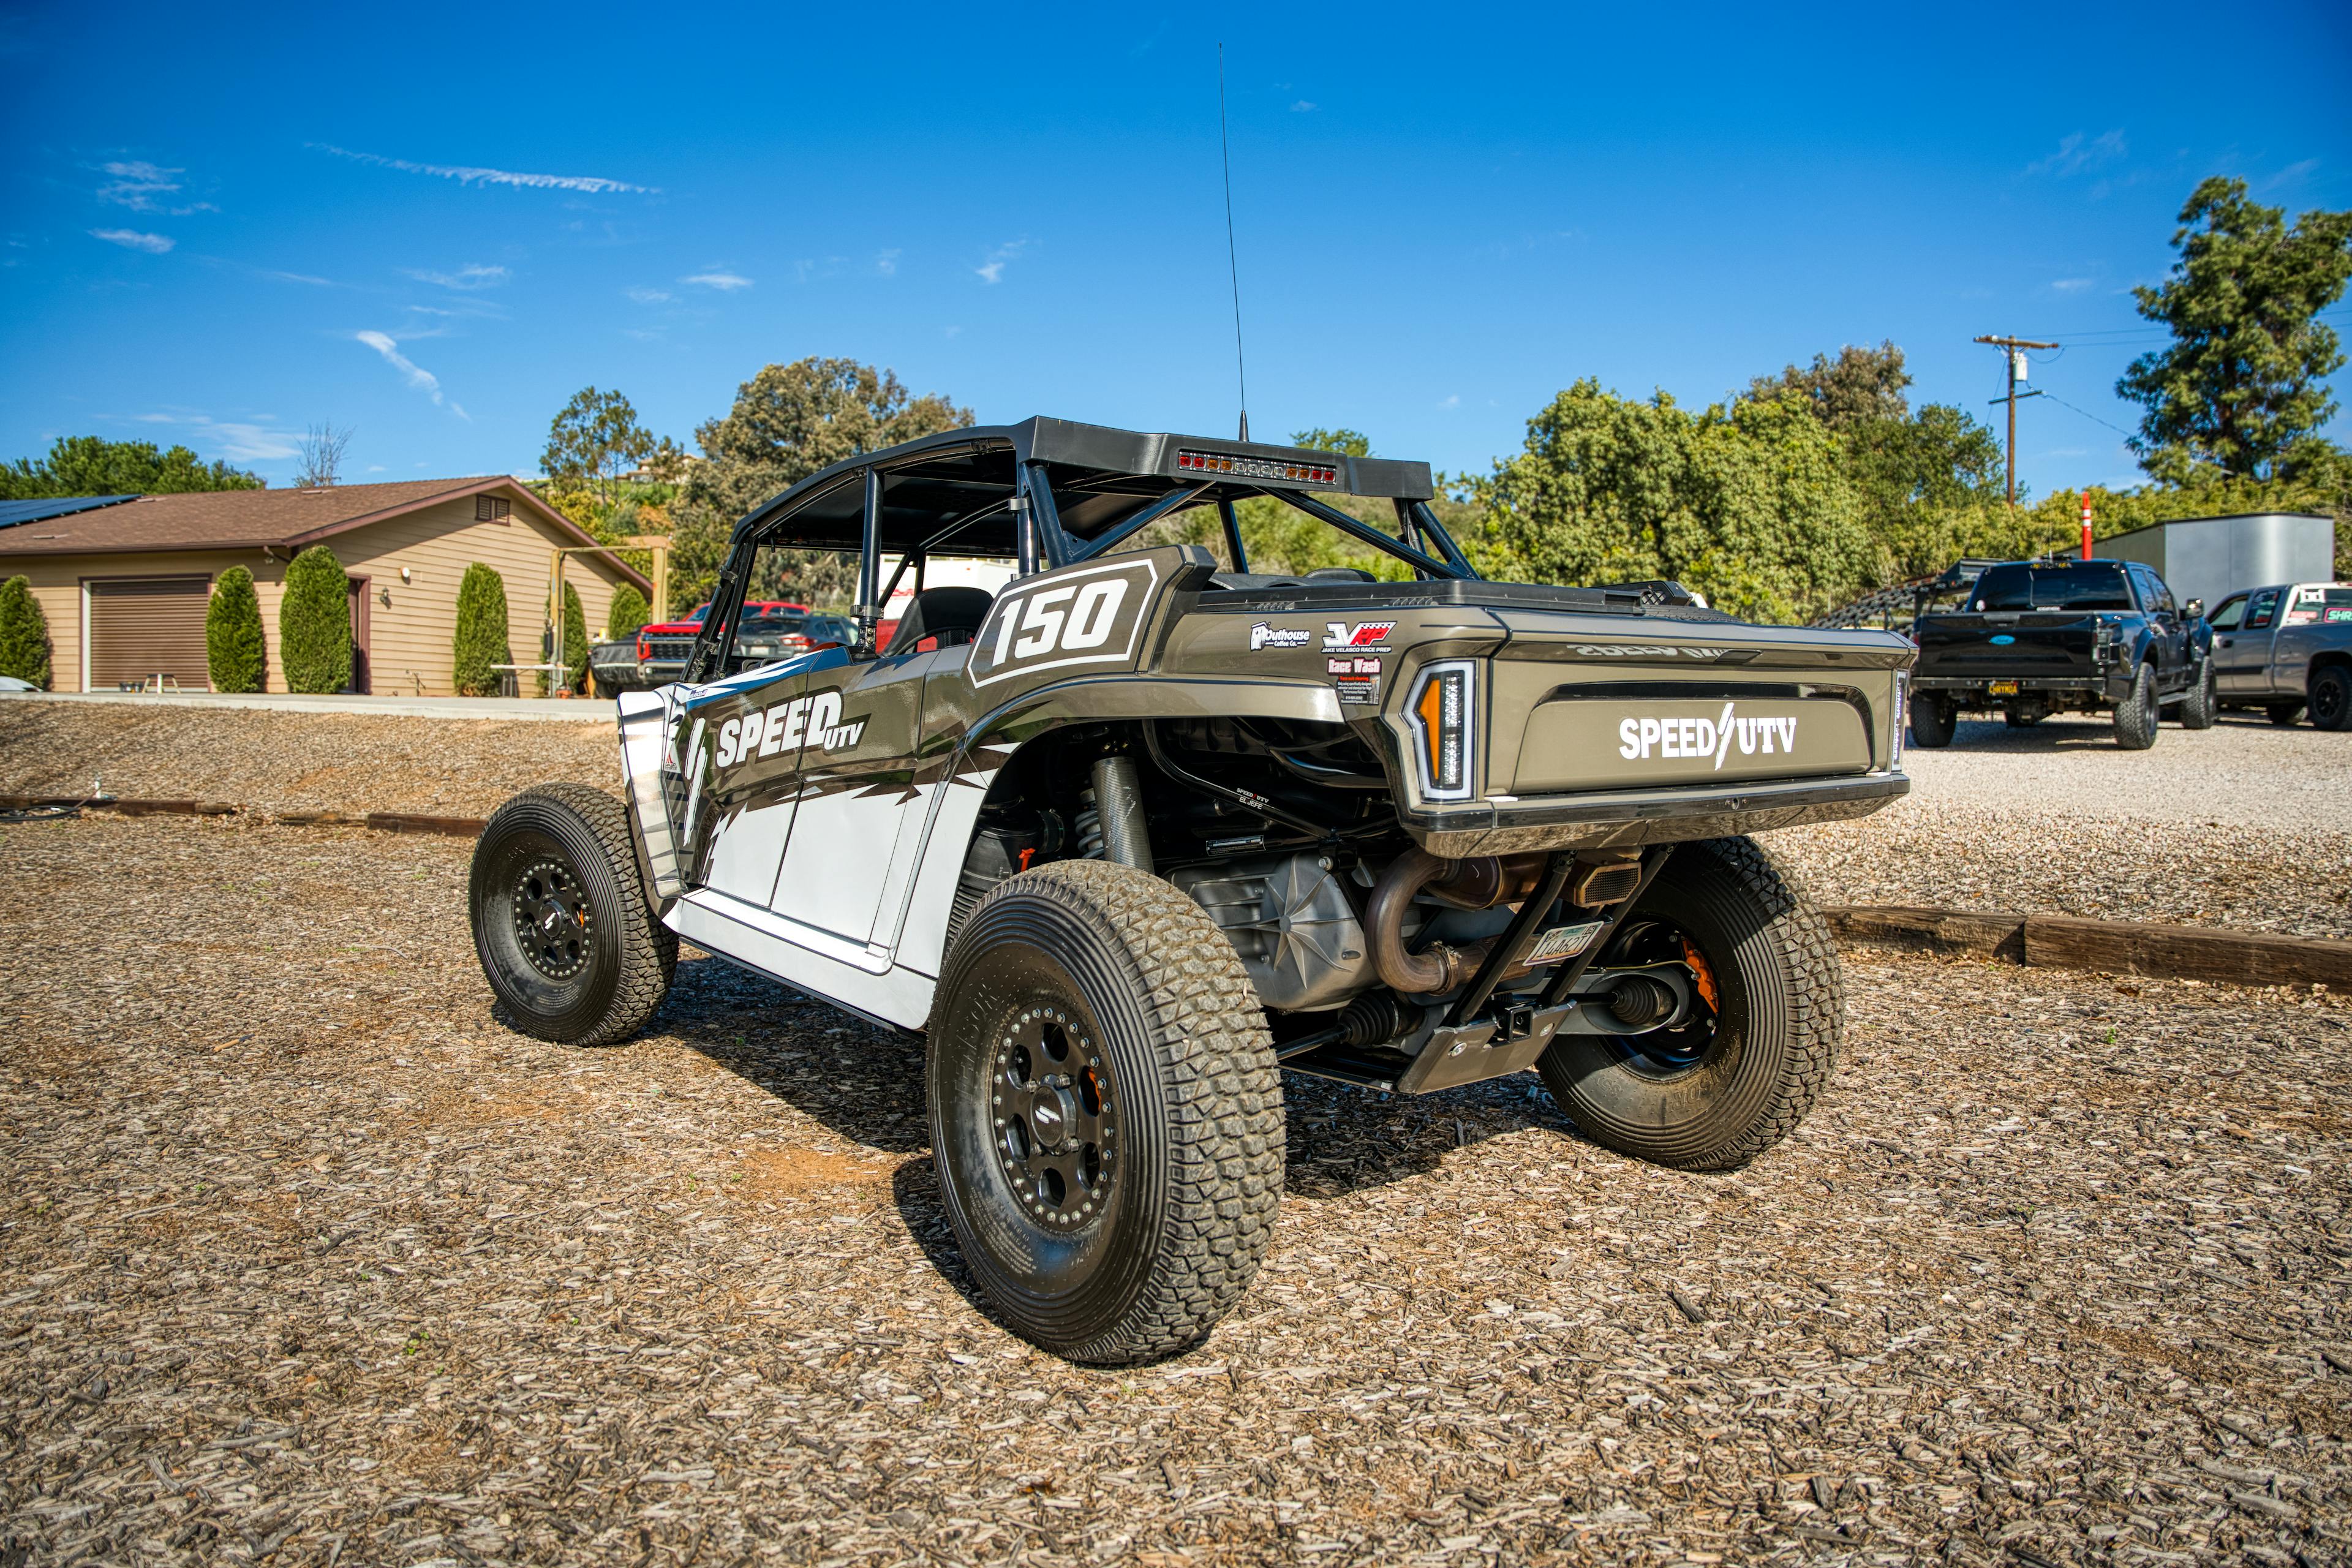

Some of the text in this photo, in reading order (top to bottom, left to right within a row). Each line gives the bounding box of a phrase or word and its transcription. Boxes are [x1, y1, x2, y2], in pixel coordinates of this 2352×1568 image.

[992, 578, 1129, 667] 150
[2328, 611, 2352, 621] SHR
[1265, 628, 1310, 641] Outhouse
[1329, 658, 1381, 673] Race Wash
[716, 691, 865, 767] SPEED UTV
[1619, 717, 1796, 760] SPEED UTV
[1237, 788, 1253, 797] SPEED
[1247, 800, 1263, 809] JEFE
[1537, 935, 1587, 958] 14A62T
